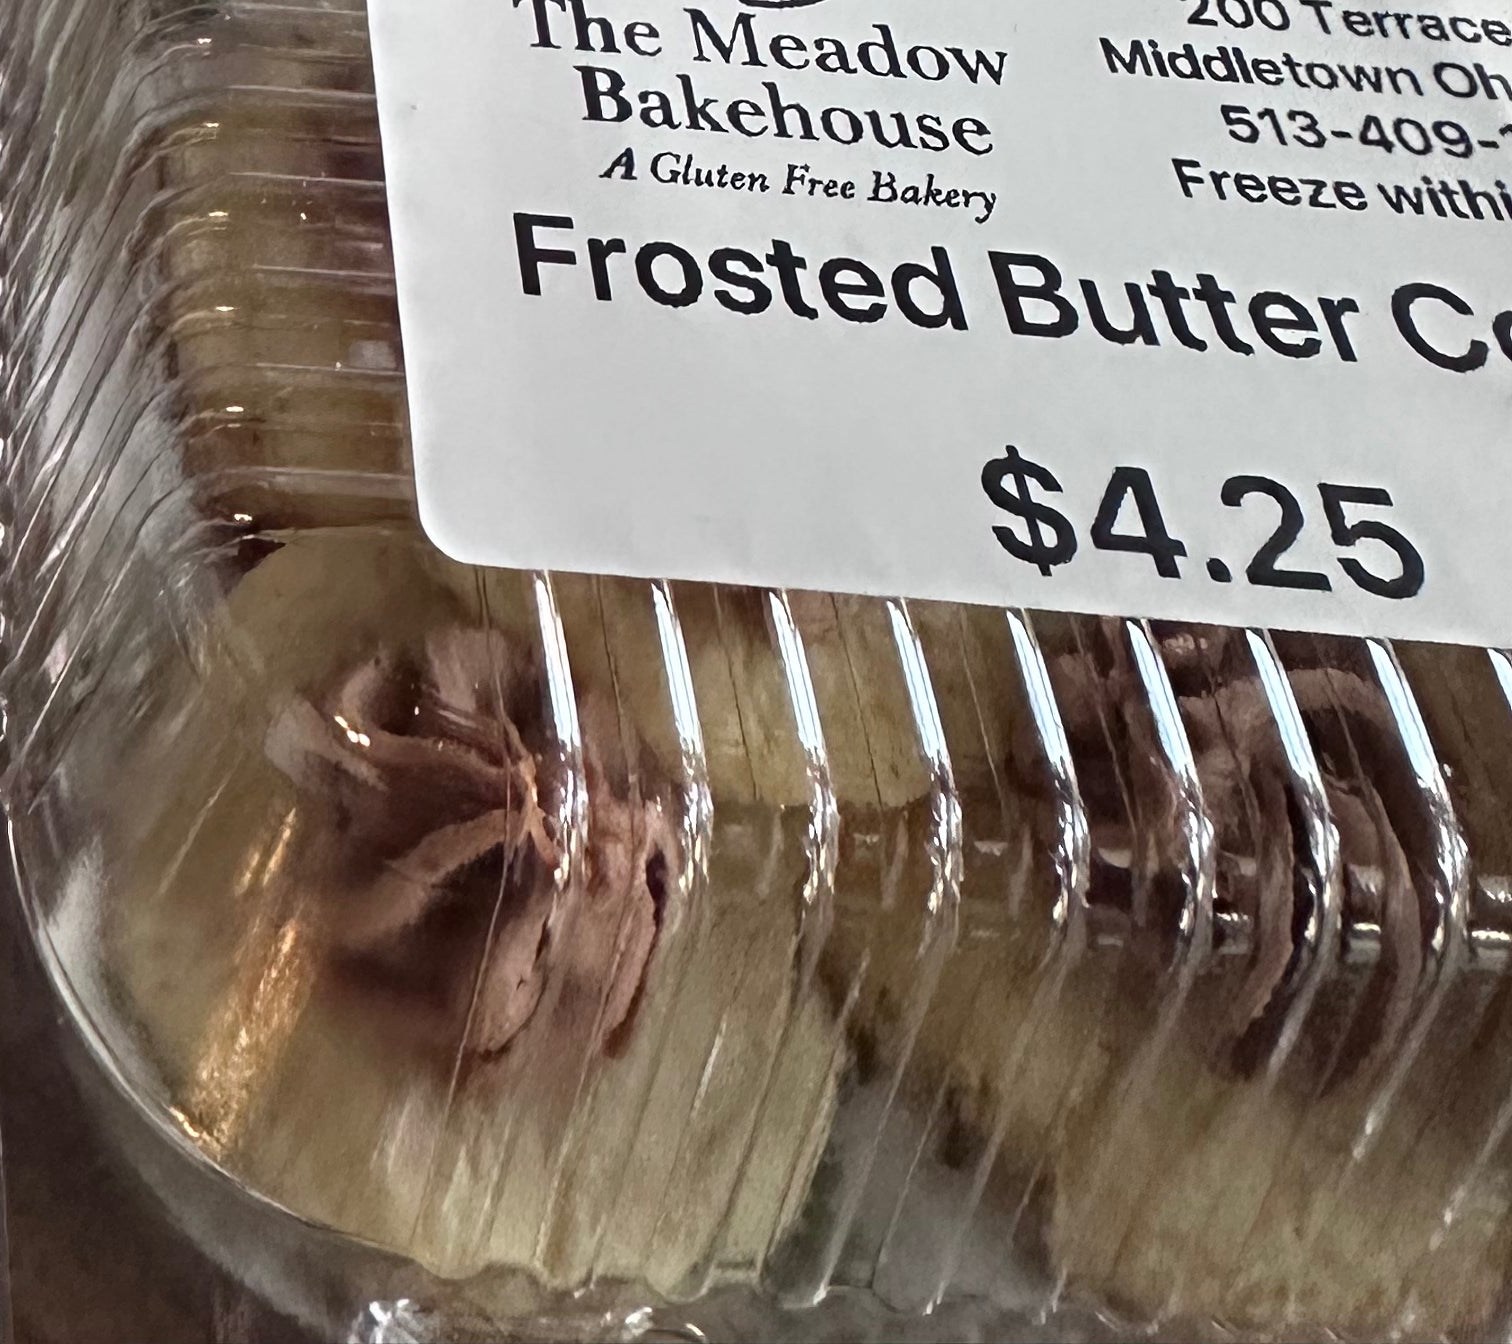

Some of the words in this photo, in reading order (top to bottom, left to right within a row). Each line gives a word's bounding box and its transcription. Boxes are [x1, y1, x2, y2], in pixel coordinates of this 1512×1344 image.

[682, 7, 1008, 86] Meadow
[1099, 37, 1424, 97] Middletown
[1432, 61, 1512, 102] Oh
[572, 65, 993, 156] Bakehouse
[598, 147, 638, 181] A
[650, 151, 770, 193] Gluten
[781, 163, 856, 200] Free
[866, 170, 997, 225] Bakery
[1171, 158, 1368, 211] Freeze
[512, 212, 969, 331] Frosted
[987, 250, 1360, 363] Butter
[980, 444, 1425, 600] $4.25
